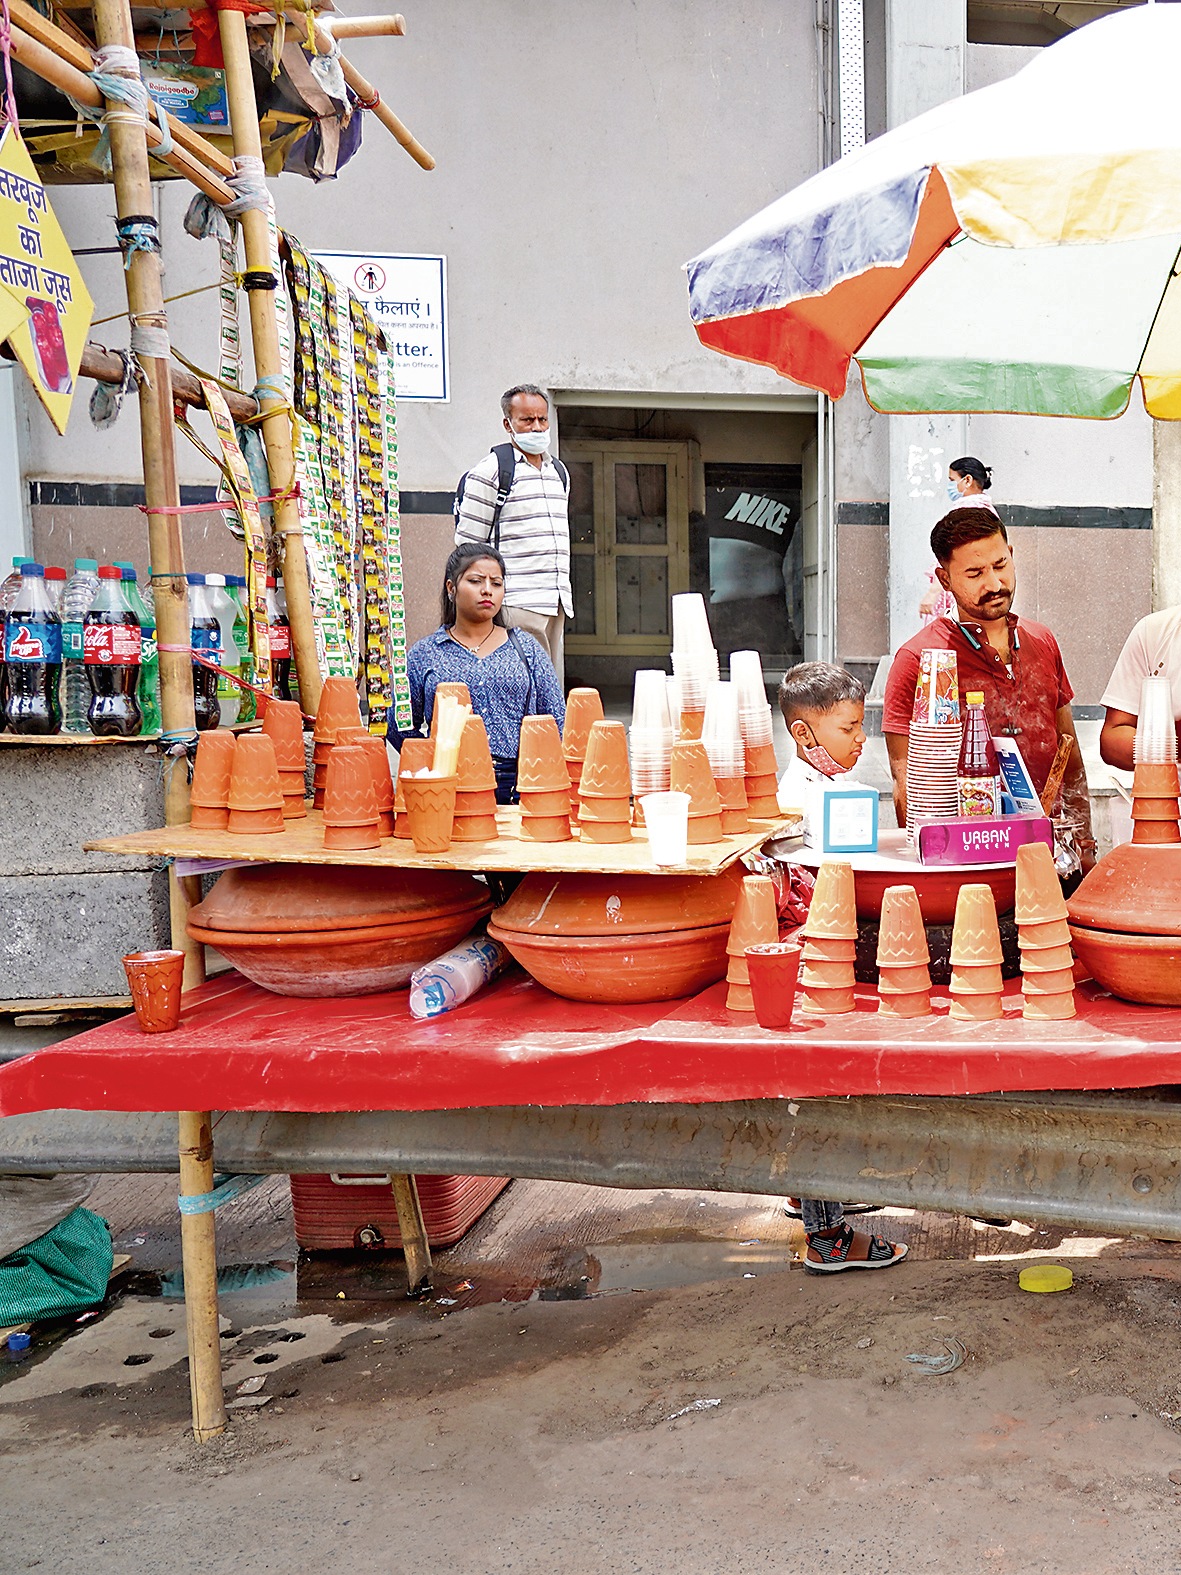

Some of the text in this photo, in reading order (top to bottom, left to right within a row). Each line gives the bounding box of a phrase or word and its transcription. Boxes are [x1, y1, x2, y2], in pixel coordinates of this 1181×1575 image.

[18, 224, 42, 258] का
[0, 254, 72, 314] ताजा जूस
[380, 341, 433, 357] tter.
[724, 492, 791, 535] NIKE
[962, 826, 1012, 844] URBAN
